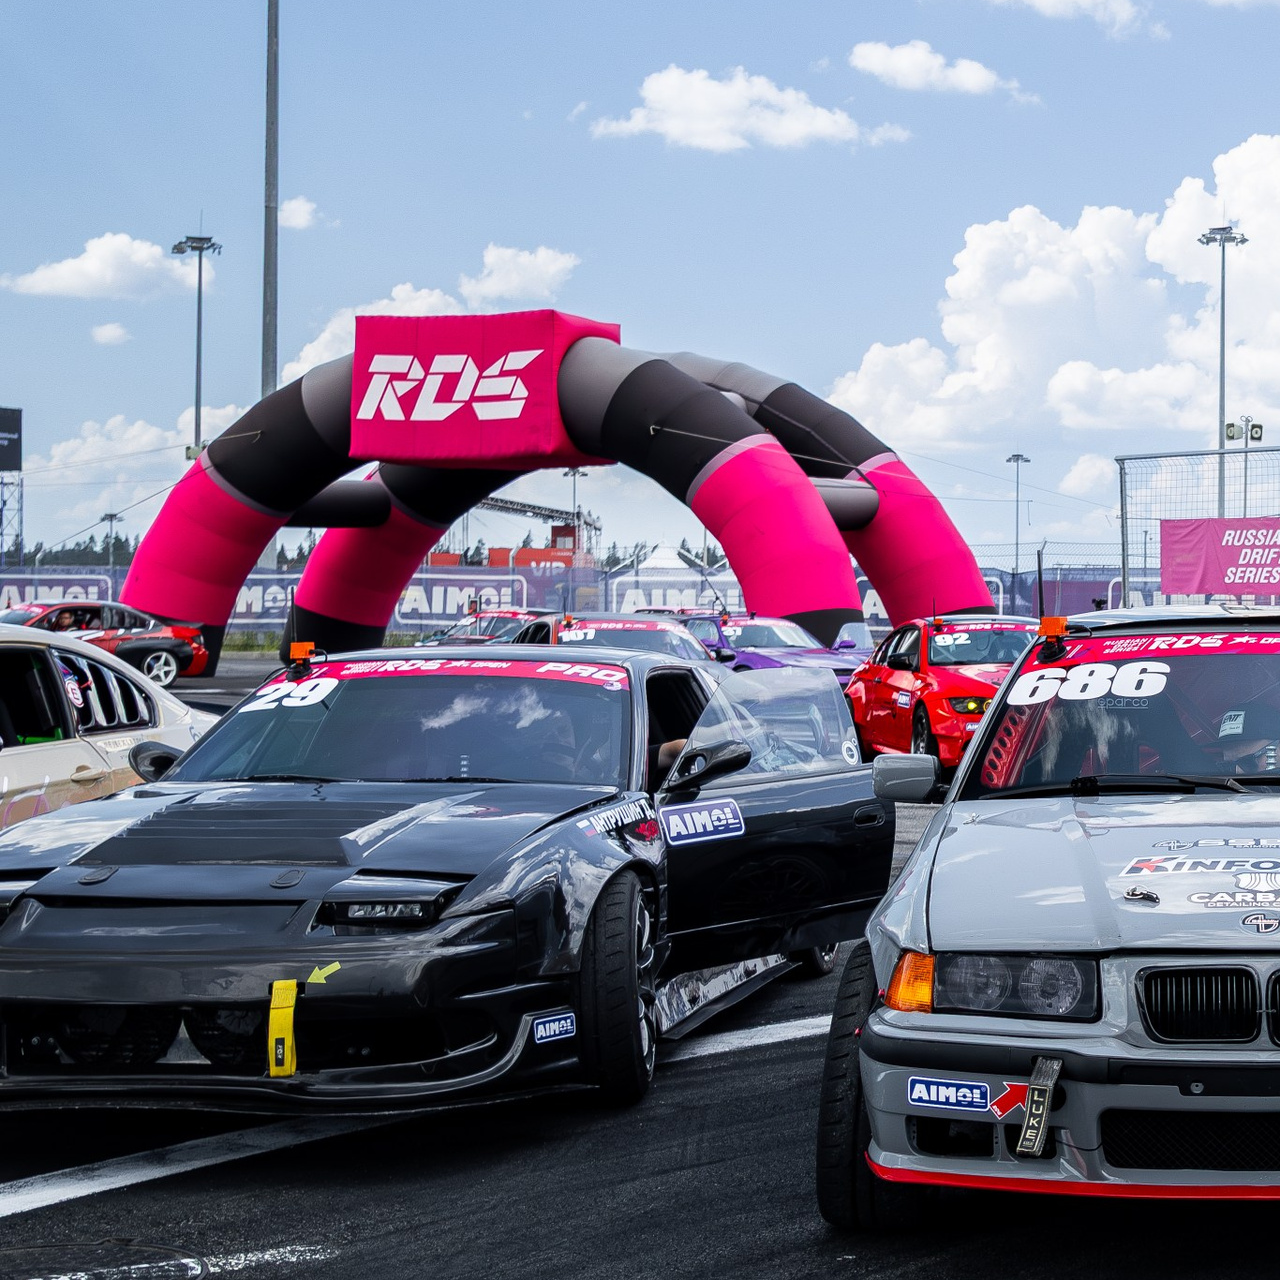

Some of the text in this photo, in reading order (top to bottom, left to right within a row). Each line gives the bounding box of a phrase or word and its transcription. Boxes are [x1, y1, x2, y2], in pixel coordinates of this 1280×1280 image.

[356, 349, 545, 421] RDS
[530, 560, 566, 576] VIP
[934, 632, 971, 646] 92
[1148, 635, 1230, 651] RDS
[378, 659, 512, 672] RDS OPEN
[536, 662, 627, 682] PRO
[1006, 661, 1171, 706] 686
[238, 677, 339, 713] 29
[1097, 696, 1149, 709] sparco
[668, 807, 741, 837] AIMOL
[537, 1018, 574, 1039] AIMOL
[911, 1083, 986, 1106] AIMOL
[1025, 1090, 1045, 1140] LUKE
